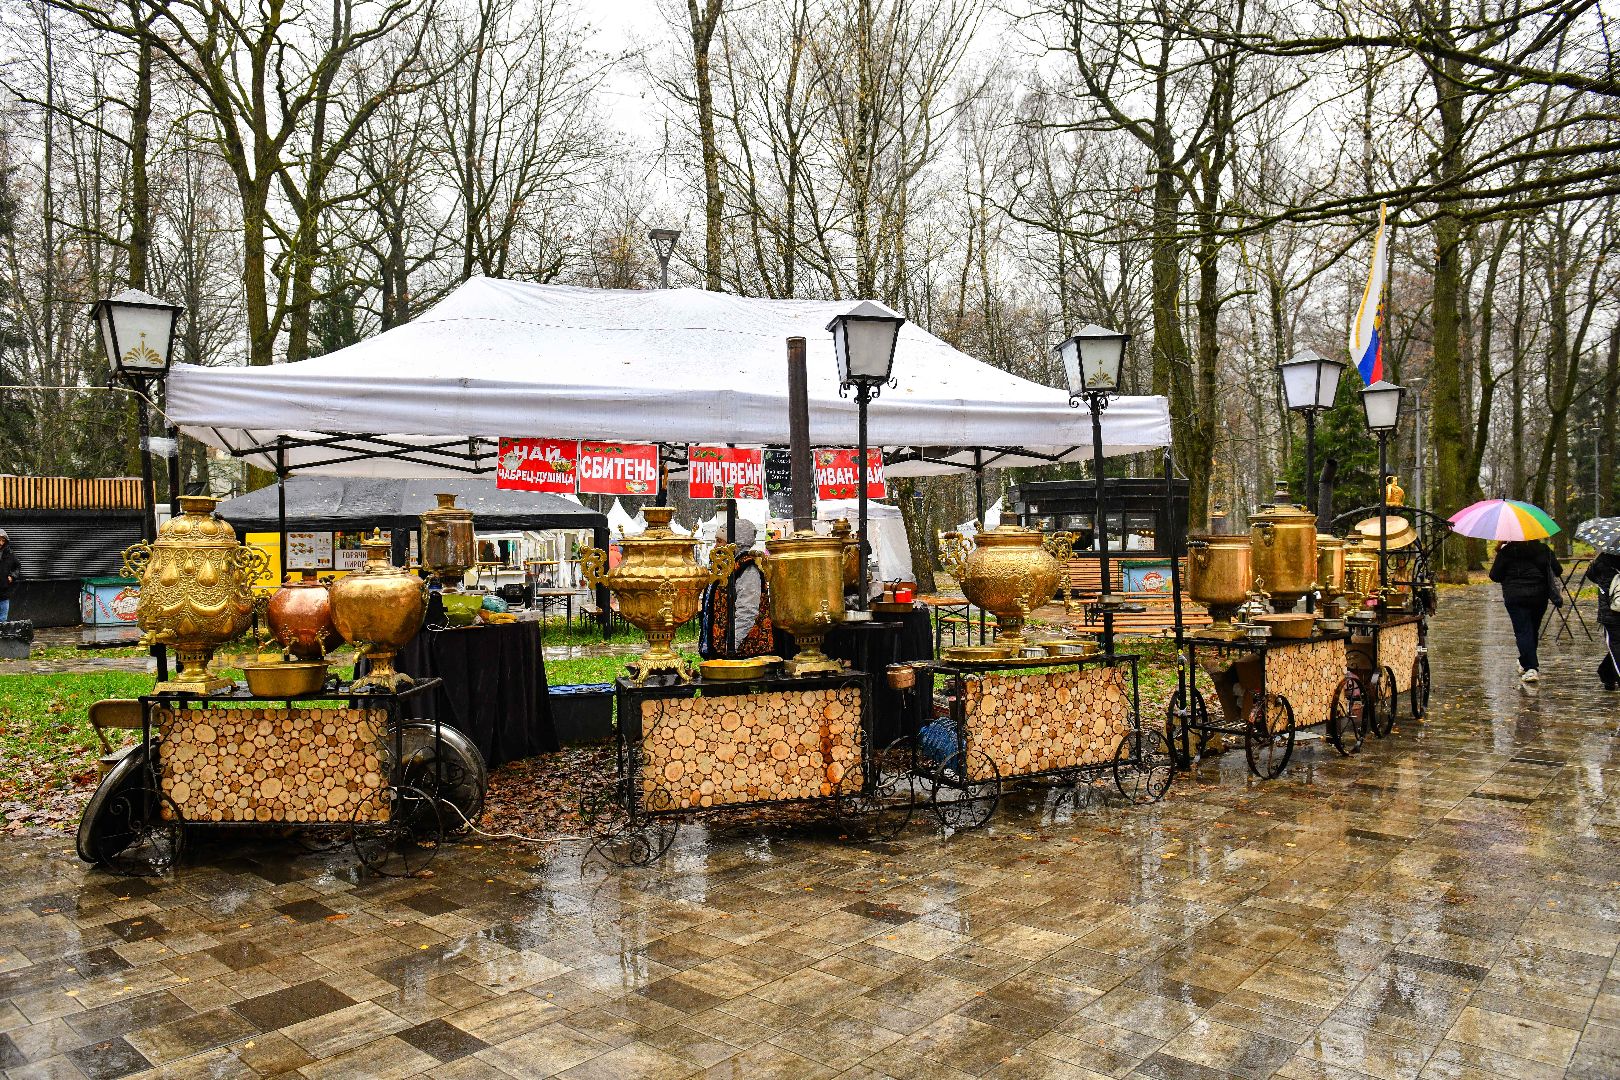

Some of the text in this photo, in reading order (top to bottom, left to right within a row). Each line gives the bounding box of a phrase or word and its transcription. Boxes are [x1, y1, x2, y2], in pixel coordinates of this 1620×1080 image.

[498, 468, 574, 486] ЧАБРЕЦ-ДУШИЦА
[580, 455, 656, 481] СБИТЕНЬ
[689, 457, 763, 485] ГЛИНТВЕЙН
[342, 551, 367, 559] ГОРЯЧИ
